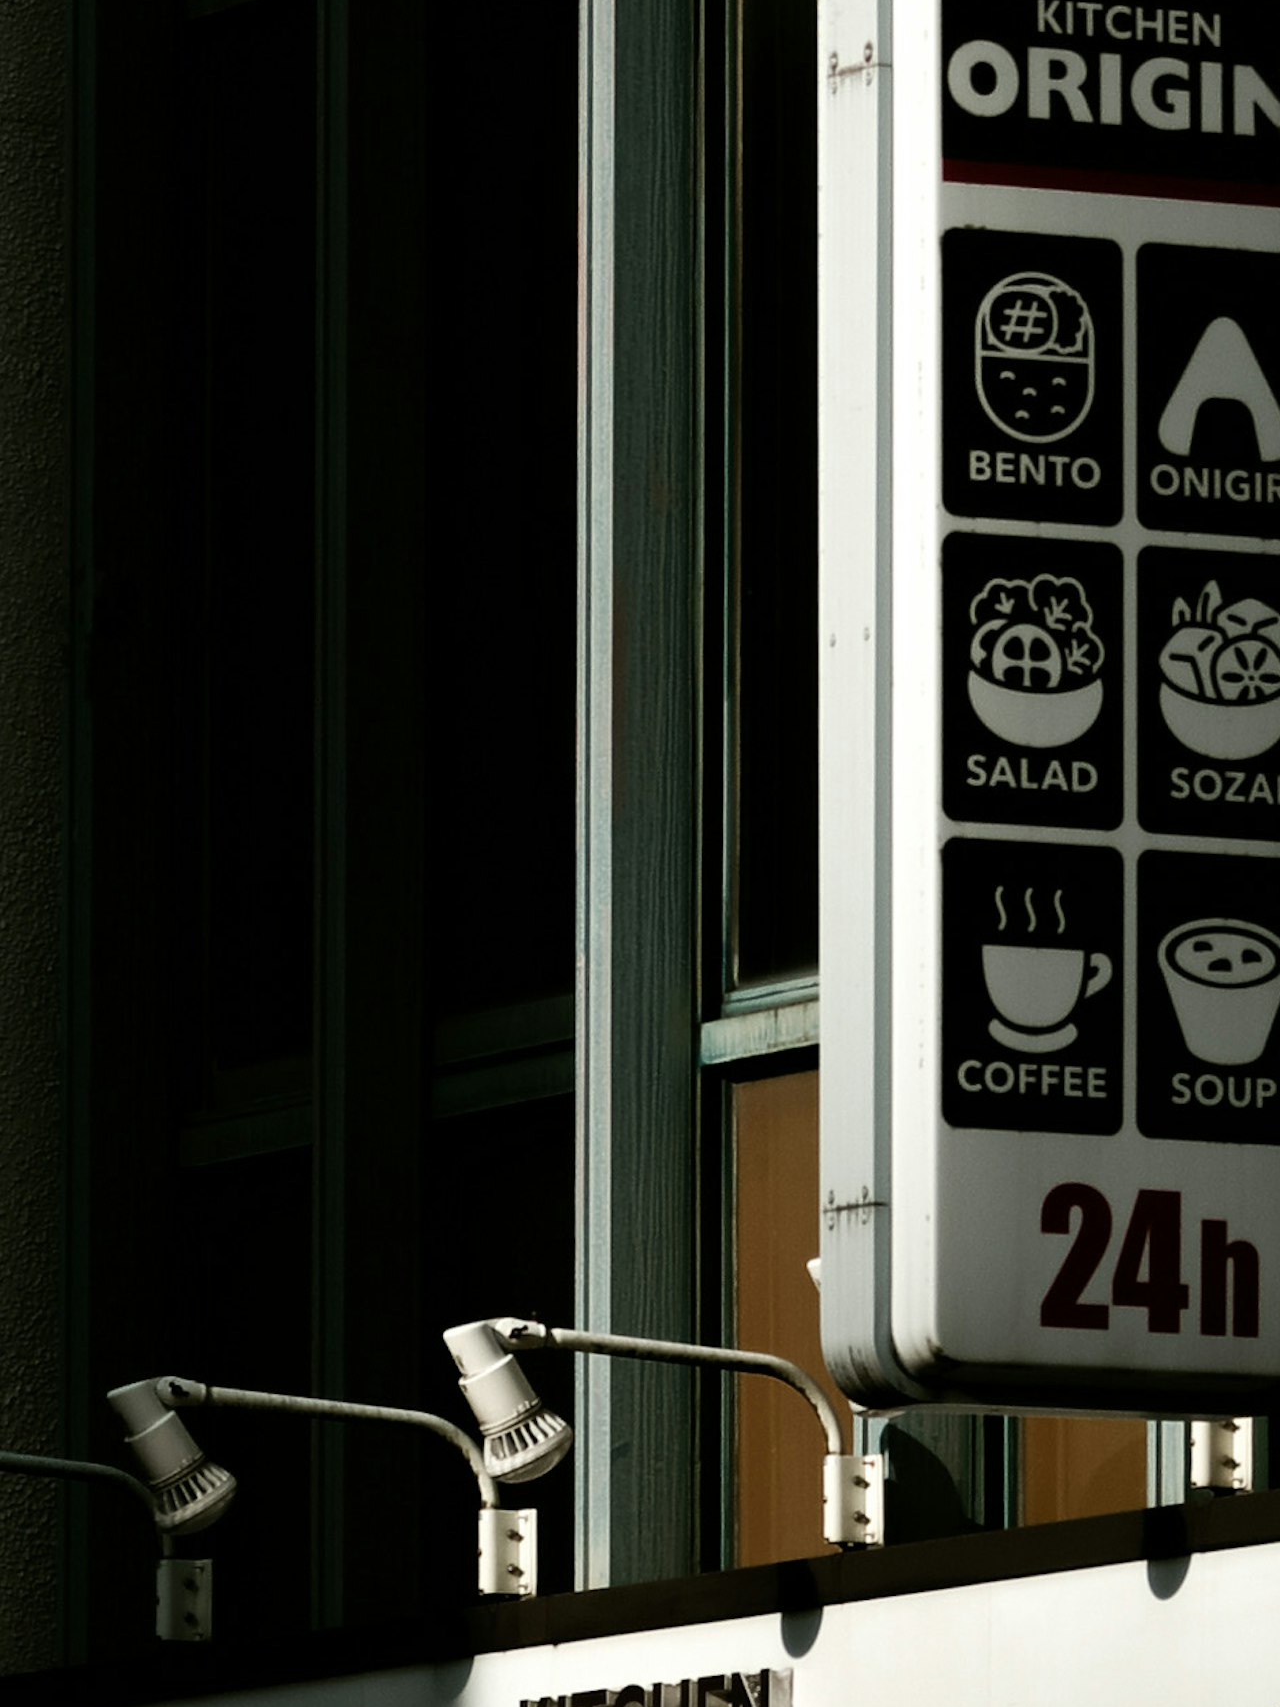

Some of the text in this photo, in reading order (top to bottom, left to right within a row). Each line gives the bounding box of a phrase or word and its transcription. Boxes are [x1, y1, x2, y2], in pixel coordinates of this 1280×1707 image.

[968, 449, 1102, 490] BENTO
[965, 754, 1099, 793] SALAD
[956, 1059, 1108, 1099] COFFEE
[1170, 1072, 1278, 1109] SOUP
[1041, 1183, 1259, 1338] 24h
